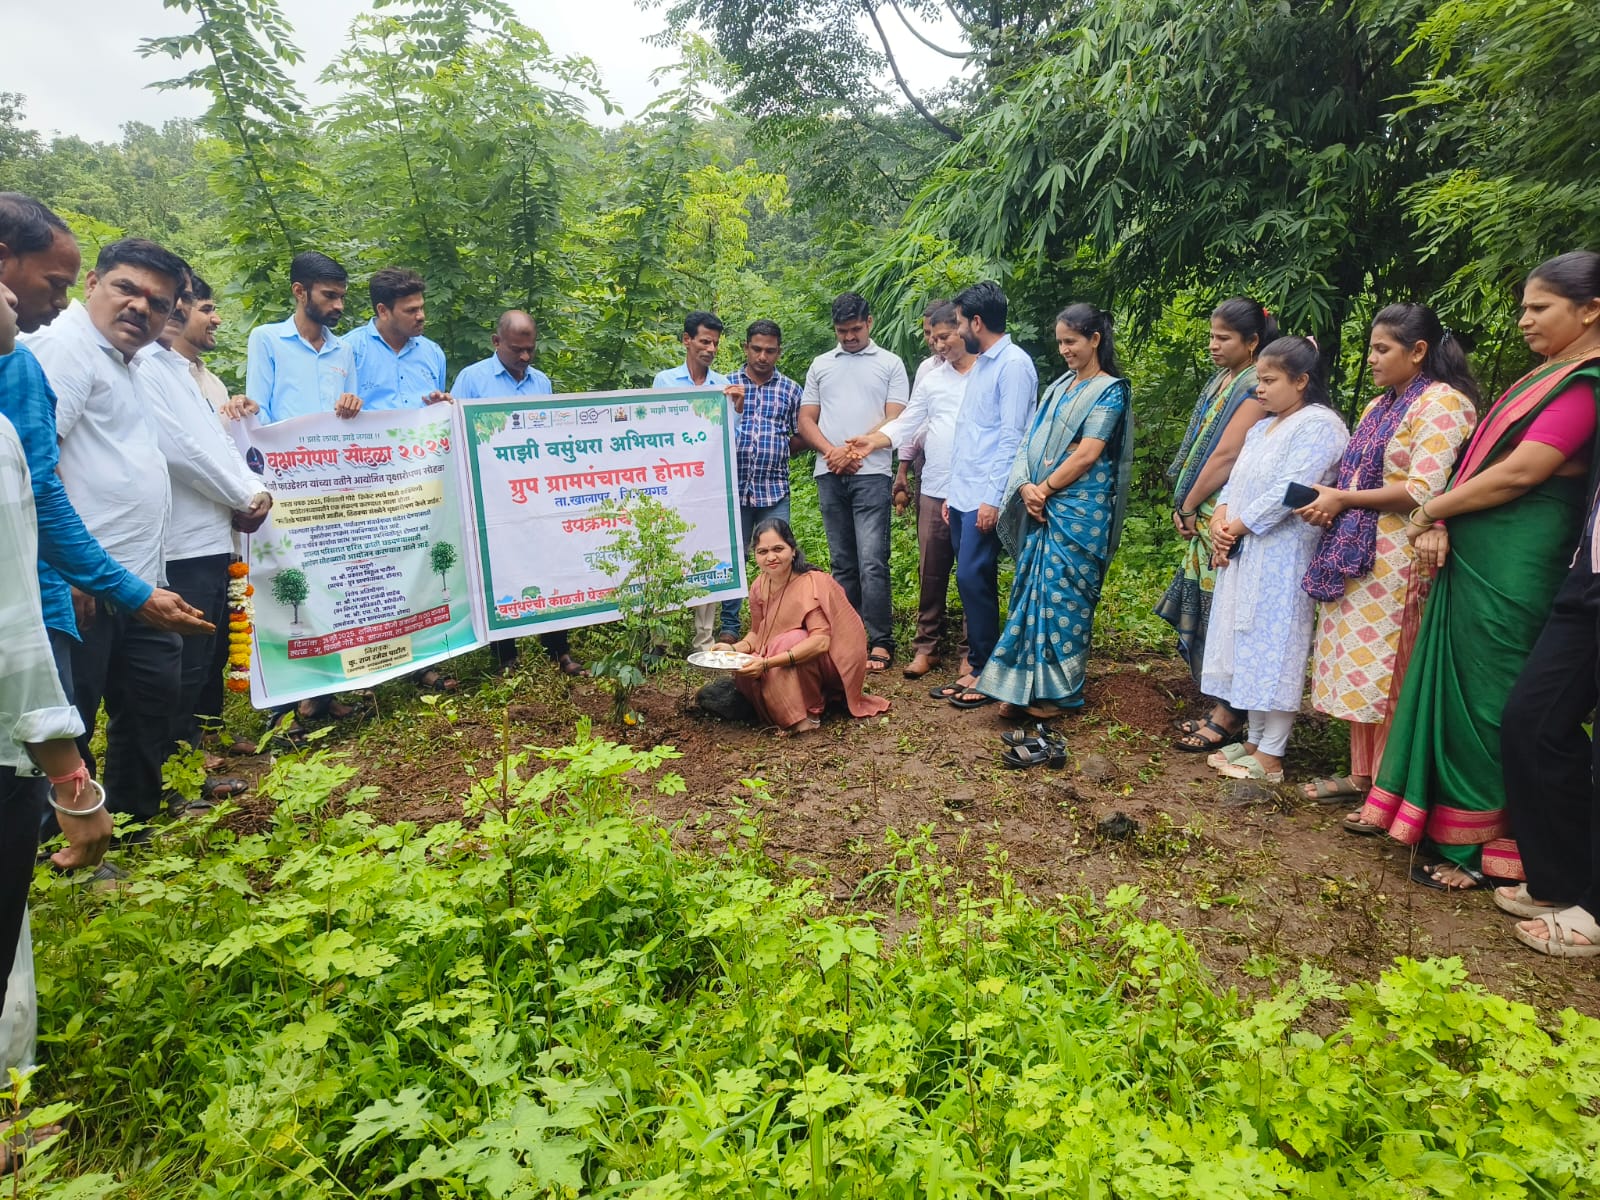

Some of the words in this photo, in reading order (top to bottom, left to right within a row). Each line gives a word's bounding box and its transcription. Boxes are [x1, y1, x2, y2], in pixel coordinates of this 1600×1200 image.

[306, 433, 320, 442] झाडे
[341, 432, 356, 441] झाडे
[493, 438, 539, 464] माझी
[544, 434, 603, 463] वसुंधरा
[610, 429, 674, 452] अभियान
[681, 431, 708, 446] ६.०
[264, 446, 339, 475] वृक्षारोपण
[342, 443, 392, 467] सोहळा
[397, 437, 450, 457] २०२५
[277, 479, 307, 490] फाउंडेशन
[308, 478, 331, 487] यांच्या
[332, 474, 352, 485] वतीने
[353, 472, 384, 483] आयोजित
[385, 469, 421, 484] वृक्षारोपण
[423, 464, 445, 473] सोहळा
[508, 476, 539, 503] ग्रुप
[544, 464, 647, 495] ग्रामपंचायत
[652, 457, 705, 482] होनाड
[345, 542, 362, 551] हरित
[347, 550, 373, 559] आयोजन
[374, 546, 400, 555] करण्यात
[402, 542, 415, 550] आले
[498, 595, 546, 617] वसुंधरेची
[548, 590, 585, 606] काळजी
[358, 655, 370, 663] राज
[388, 646, 406, 655] पाटील
